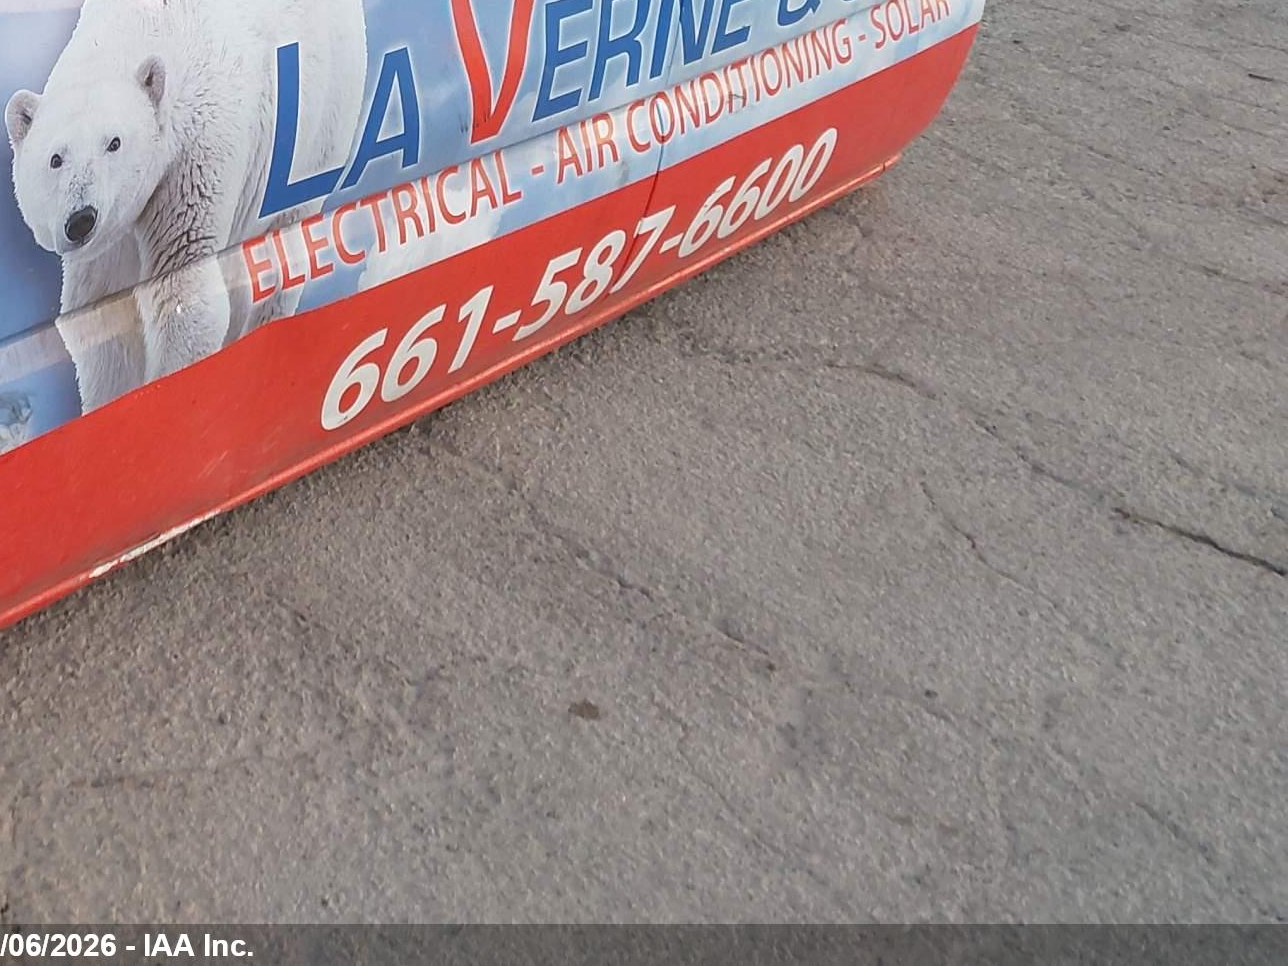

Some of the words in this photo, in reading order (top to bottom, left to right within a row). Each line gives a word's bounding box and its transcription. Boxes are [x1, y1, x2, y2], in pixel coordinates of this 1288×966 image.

[244, 148, 521, 304] ELECTRICAL
[556, 112, 617, 184] AIR
[627, 19, 852, 151] CONDITIONING
[321, 127, 838, 431] 661-587-6600
